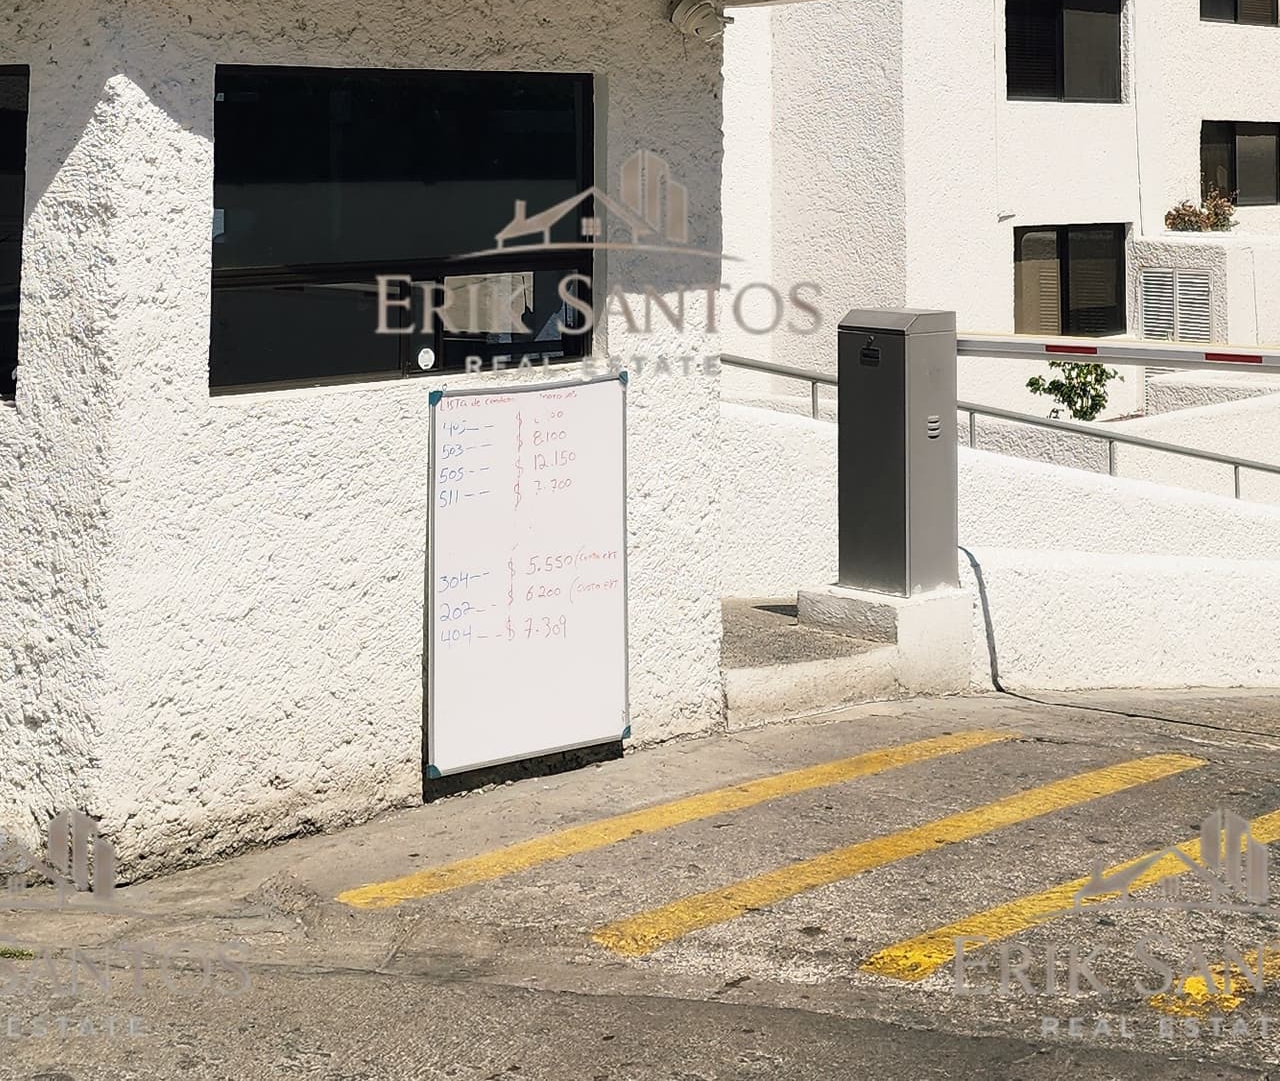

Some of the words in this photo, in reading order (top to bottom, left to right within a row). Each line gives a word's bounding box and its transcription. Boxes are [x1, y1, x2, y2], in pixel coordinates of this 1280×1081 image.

[441, 444, 465, 460] 503
[439, 467, 465, 484] 505
[439, 489, 460, 508] 511
[438, 572, 469, 594] 304
